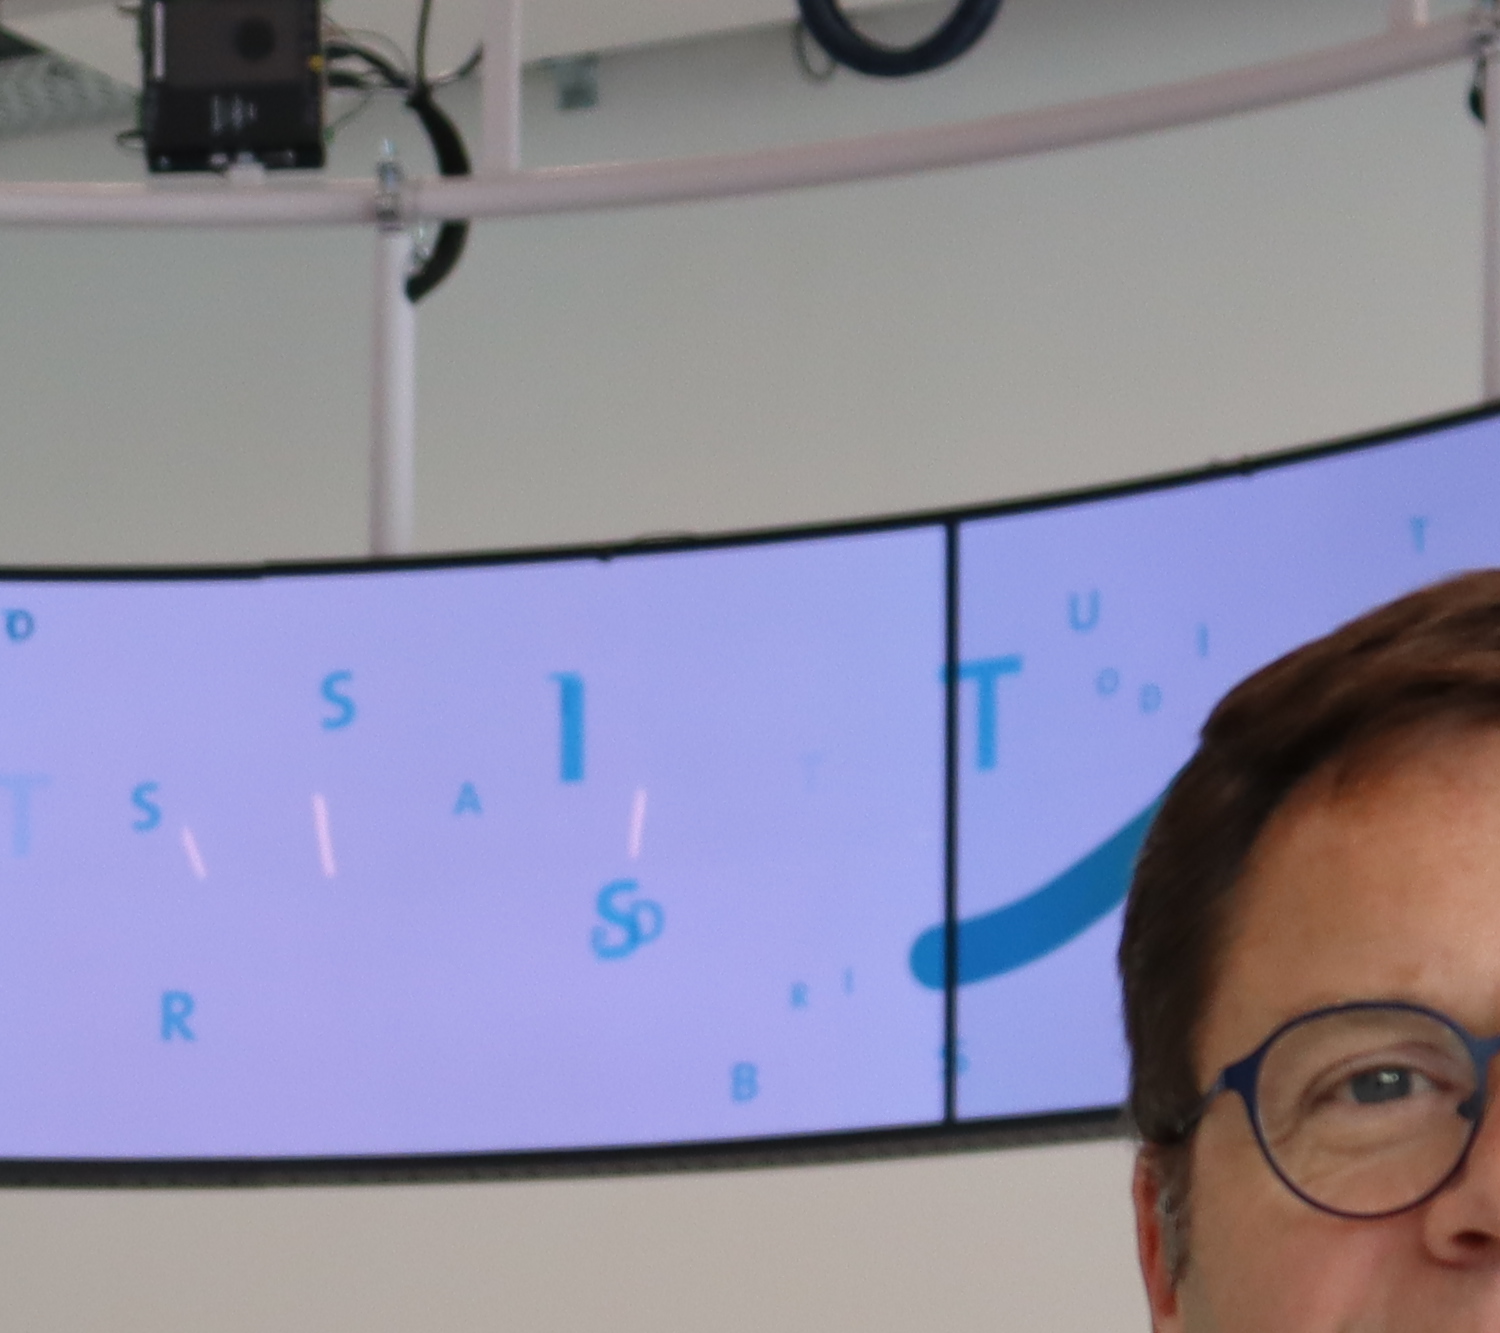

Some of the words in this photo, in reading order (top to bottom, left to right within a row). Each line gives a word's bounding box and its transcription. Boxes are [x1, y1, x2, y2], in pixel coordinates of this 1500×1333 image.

[1067, 588, 1101, 634] U
[319, 669, 358, 731] S
[938, 654, 1024, 774] T
[131, 780, 163, 834] S
[452, 780, 484, 817] A
[590, 877, 642, 963] S
[159, 989, 198, 1043] R
